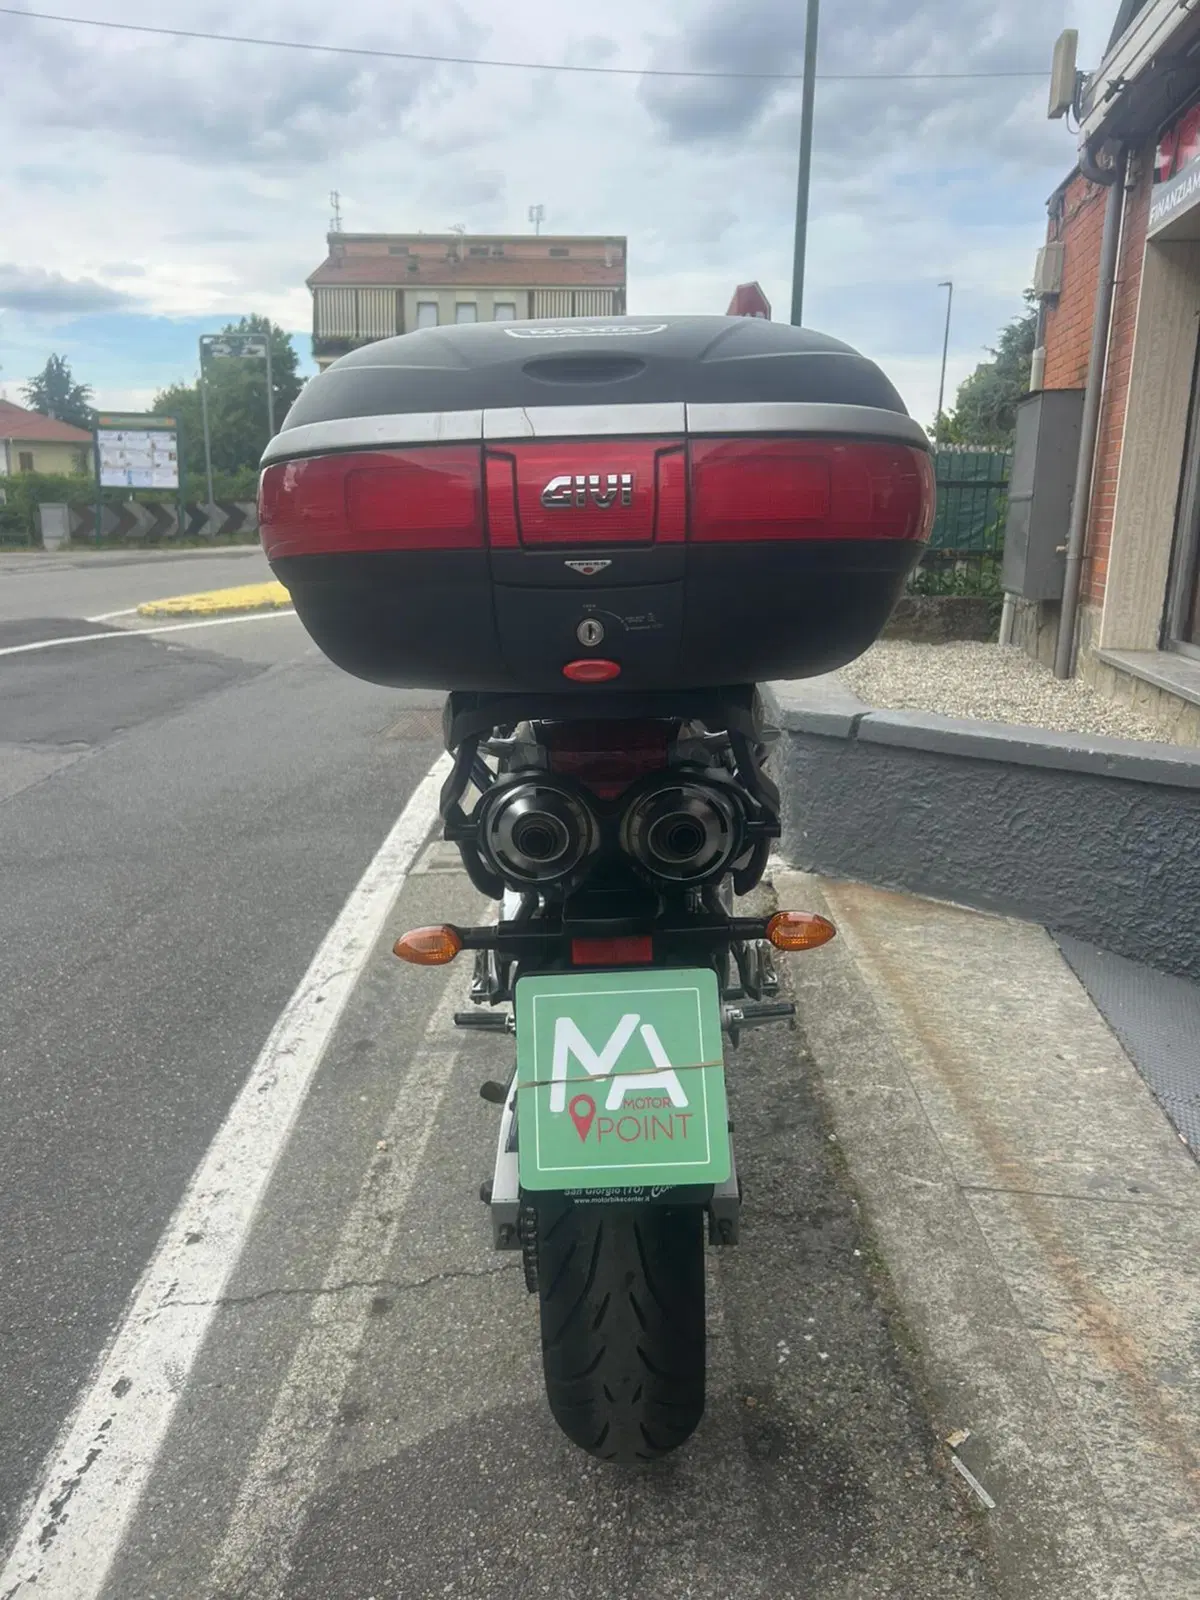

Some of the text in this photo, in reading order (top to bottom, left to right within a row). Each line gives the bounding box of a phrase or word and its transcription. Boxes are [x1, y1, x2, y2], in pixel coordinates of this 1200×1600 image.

[541, 474, 632, 508] GIVI
[550, 1014, 689, 1113] MA
[623, 1097, 672, 1112] MOTOR
[597, 1114, 693, 1144] POINT
[574, 1195, 650, 1204] www.motorbikecenter.it
